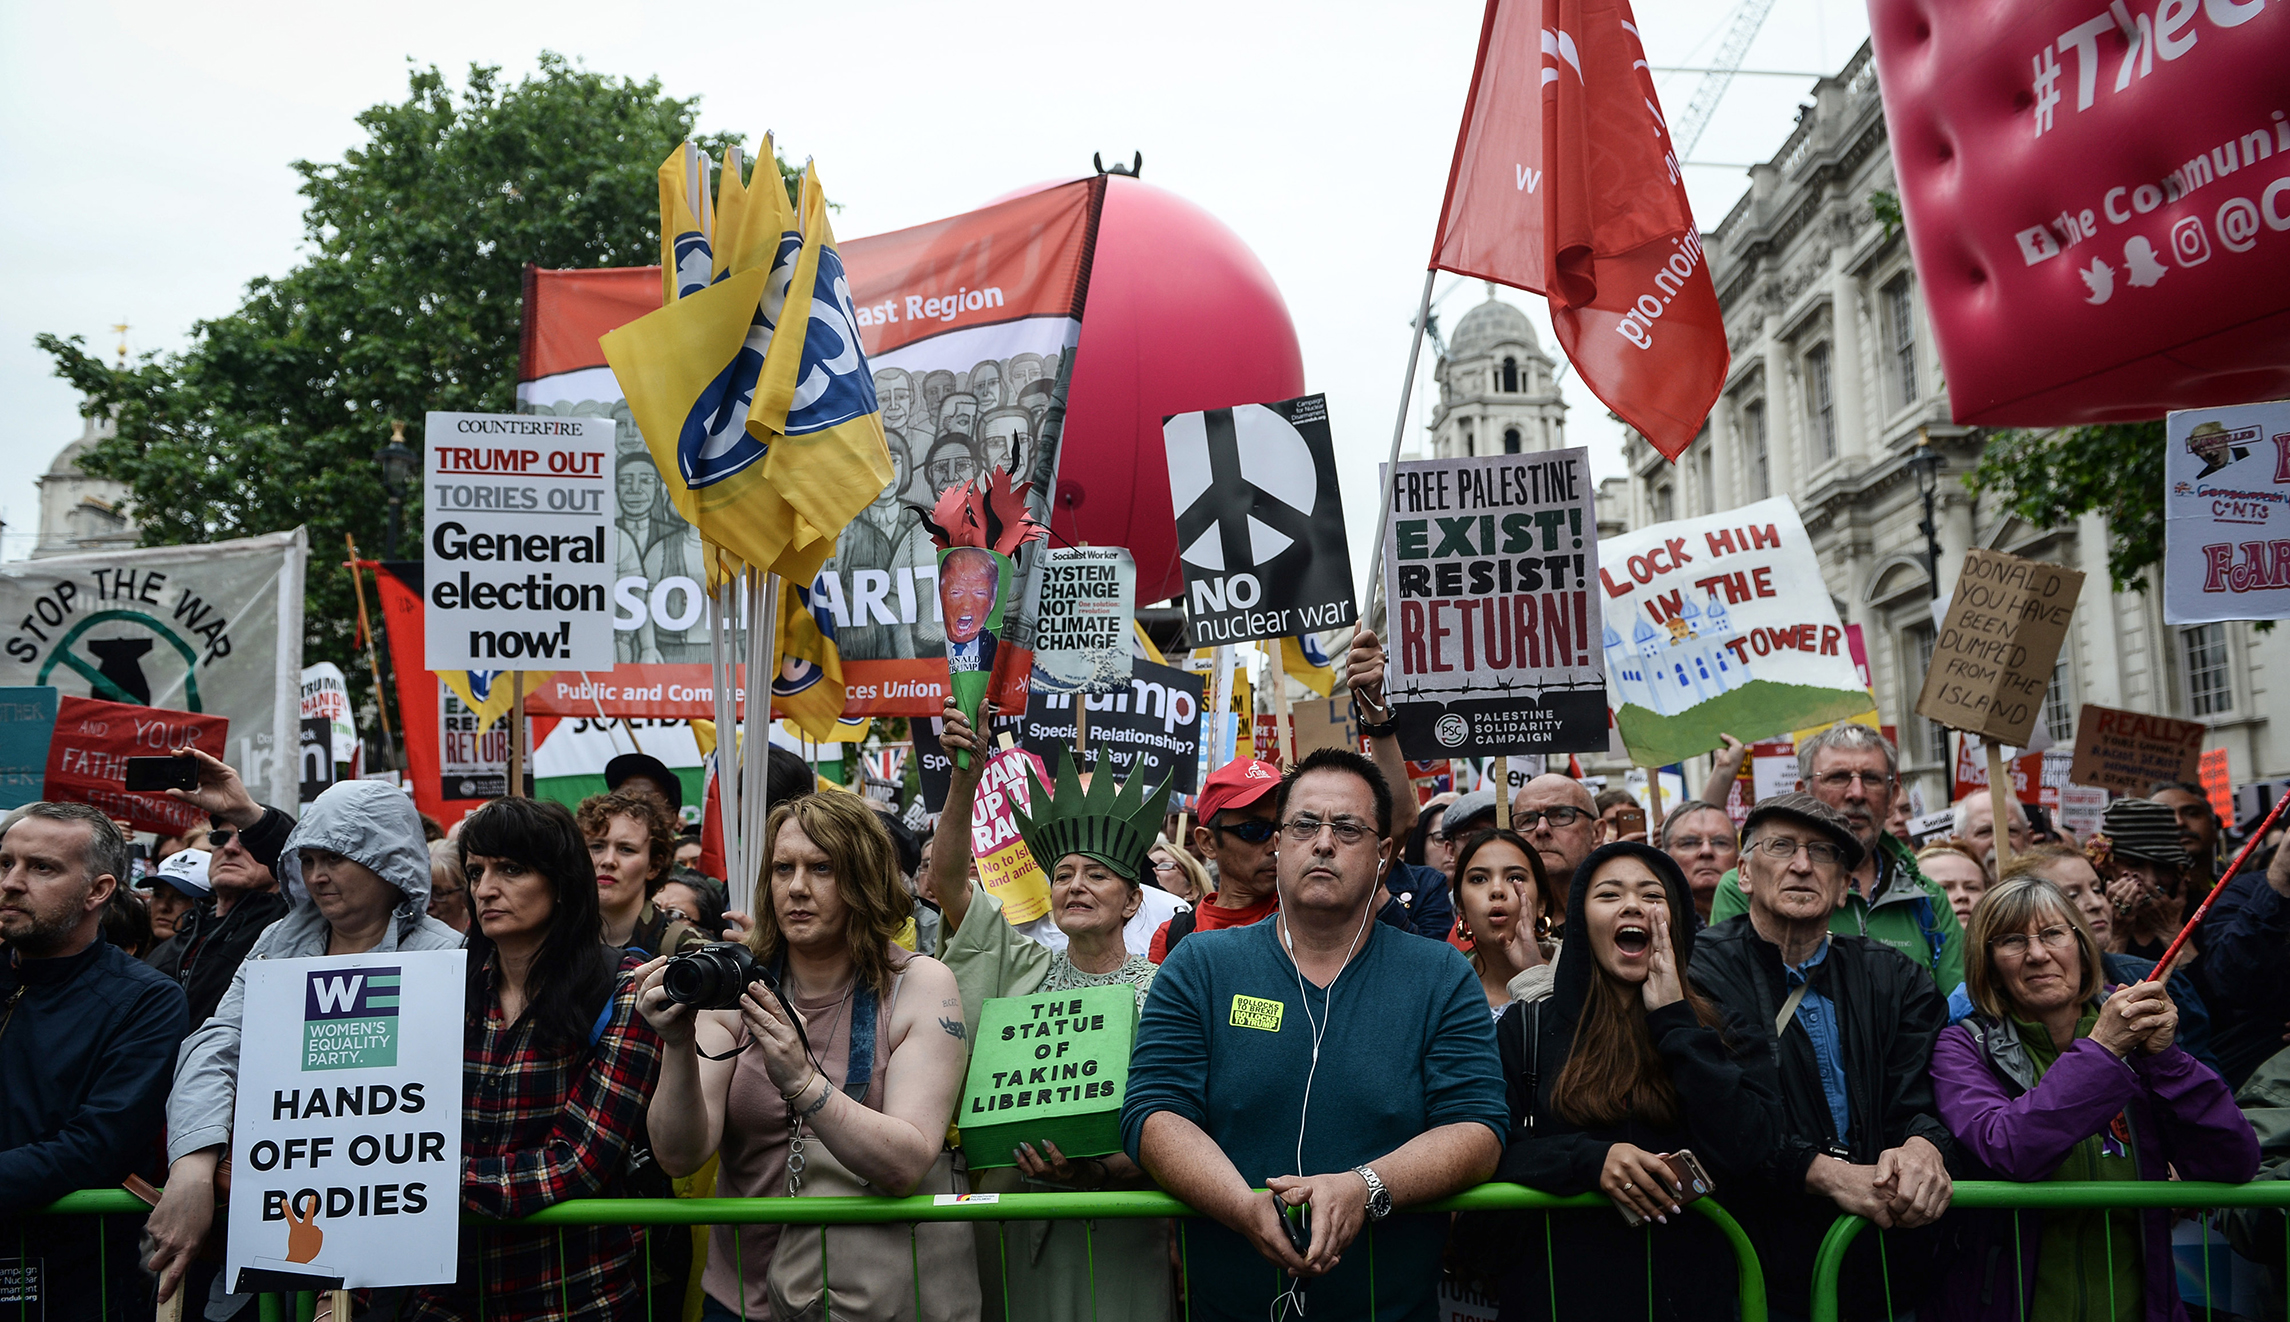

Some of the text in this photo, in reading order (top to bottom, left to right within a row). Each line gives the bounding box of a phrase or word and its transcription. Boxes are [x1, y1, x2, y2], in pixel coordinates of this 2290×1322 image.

[2053, 209, 2097, 249] The
[856, 285, 1004, 327] ast Region
[457, 420, 583, 436] COUNTERFIRE
[434, 447, 605, 475] TRUMP OUT
[434, 485, 604, 511] TORIES OUT
[1394, 460, 1580, 513] FREE PALESTINE
[432, 521, 605, 564] General
[1397, 508, 1582, 560] EXIST!
[1052, 550, 1119, 561] Socialist Worker
[1600, 523, 1781, 599] LOCK HIM
[1042, 565, 1116, 582] SYSTEM
[1399, 554, 1586, 598] RESIST!
[1963, 555, 2061, 597] DONALD
[432, 571, 605, 611] election
[1040, 582, 1120, 599] CHANGE
[1191, 572, 1262, 616] NO
[1644, 566, 1776, 625] IN THE
[1958, 579, 2072, 626] YOU HAVE
[6, 568, 232, 669] STOP THE WAR
[1038, 600, 1076, 616] NOT
[1196, 600, 1350, 643] nuclear war
[1959, 609, 2020, 638] BEEN
[469, 621, 571, 659] now!
[1037, 616, 1121, 633] CLIMATE
[1399, 590, 1589, 675] RETURN!
[1035, 634, 1117, 651] CHANGE
[1725, 623, 1842, 665] TOWER
[1940, 628, 2027, 668] DUMPED
[557, 681, 617, 701] Public
[622, 684, 663, 702] and
[883, 681, 941, 698] Union
[1946, 657, 2043, 696] FROM THE
[1474, 710, 1554, 723] PALESTINE
[1938, 682, 2028, 725] ISLAND
[78, 718, 203, 750] AND YOUR
[1090, 726, 1195, 755] Relationship?
[1442, 726, 1462, 737] PSC
[1474, 720, 1563, 734] SOLIDARITY
[1475, 732, 1553, 745] CAMPAIGN
[2098, 710, 2203, 747] REALLY?
[61, 747, 128, 781] FATHE
[972, 792, 1003, 827] UP
[982, 862, 1000, 875] No
[1002, 855, 1014, 867] to
[989, 871, 1010, 888] and
[312, 974, 401, 1014] WE
[1030, 999, 1083, 1020] THE
[1237, 998, 1279, 1011] BOLLOCKS
[1234, 1011, 1278, 1024] BOLLOCKS
[1235, 1017, 1276, 1029] TO TRUMP
[1250, 1006, 1277, 1016] BREXIT
[308, 1034, 391, 1051] EQUALITY
[309, 1021, 386, 1038] WOMEN'S
[1000, 1014, 1104, 1042] STATUE
[307, 1050, 364, 1066] PARTY.
[1034, 1041, 1070, 1060] OF
[991, 1059, 1098, 1089] TAKING
[272, 1082, 427, 1121] HANDS
[971, 1080, 1115, 1113] LIBERTIES
[249, 1130, 446, 1171] OFF OUR
[262, 1182, 429, 1222] BODIES
